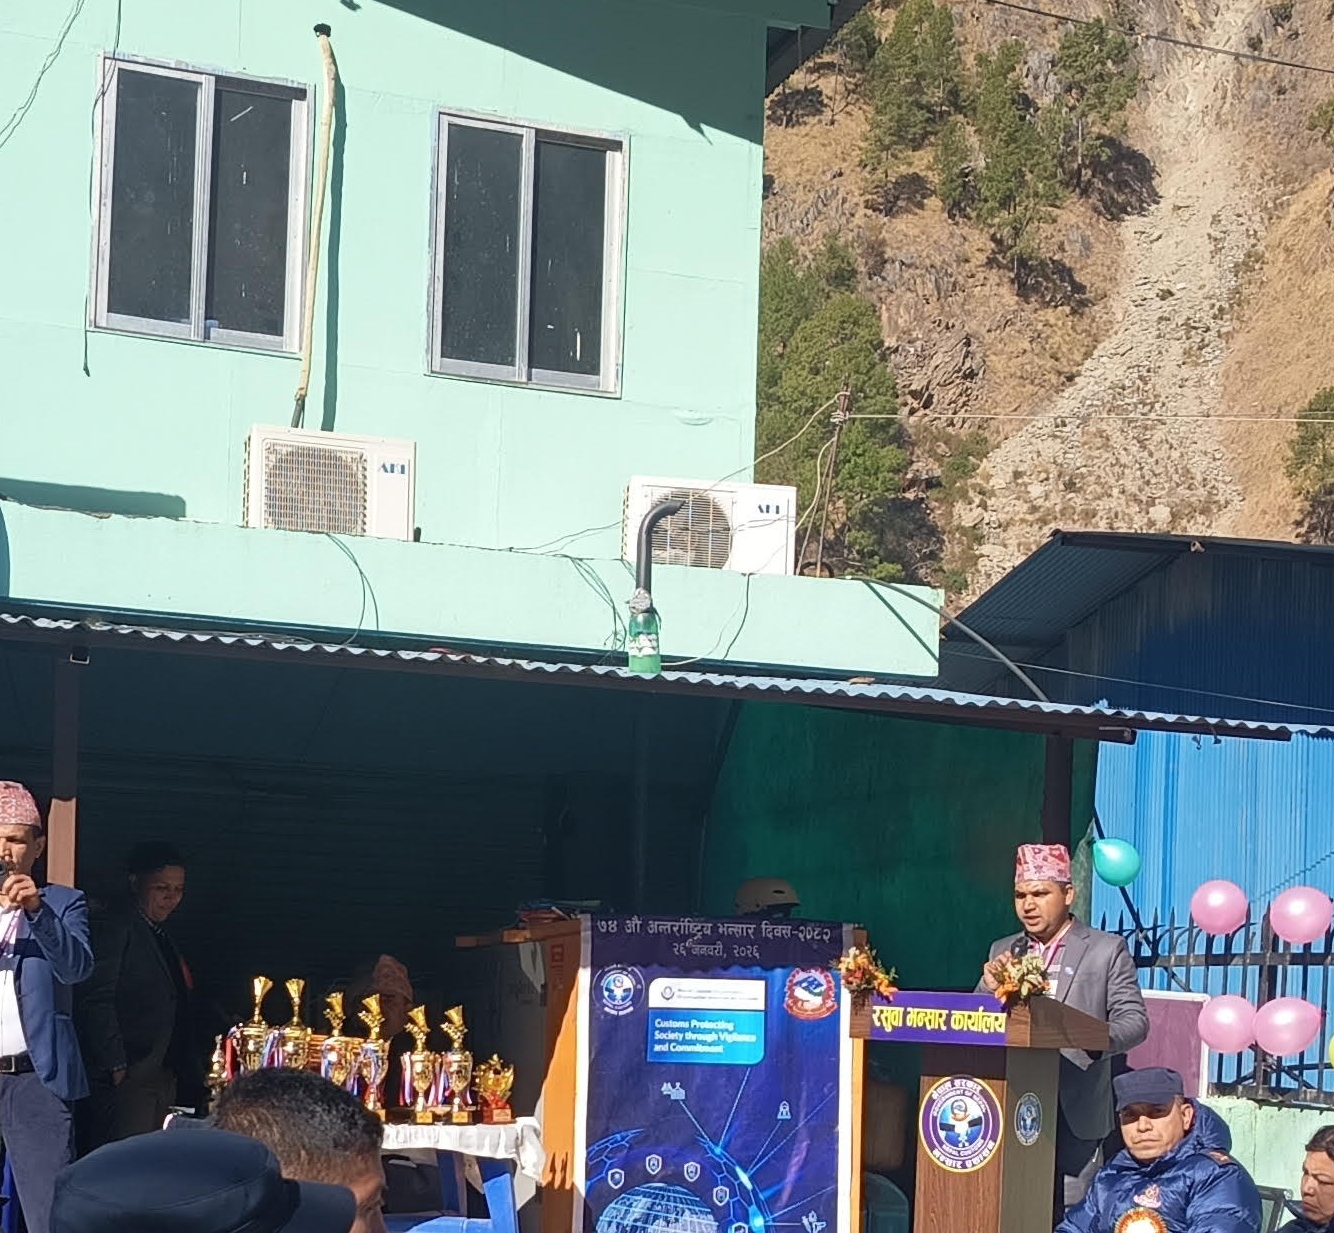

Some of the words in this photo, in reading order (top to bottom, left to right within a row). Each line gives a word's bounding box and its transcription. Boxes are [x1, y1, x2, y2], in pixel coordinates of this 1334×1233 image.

[597, 920, 617, 933] ७४
[717, 921, 755, 939] भन्सार
[673, 943, 687, 957] २६
[733, 944, 759, 958] २०२६
[655, 1019, 689, 1028] Customs
[691, 1019, 734, 1031] Protecting
[872, 1005, 904, 1032] रसुवा
[906, 1007, 948, 1031] भन्सार
[950, 1006, 1007, 1033] कार्यालय
[654, 1030, 683, 1041] Society
[685, 1031, 718, 1043] through
[718, 1032, 757, 1043] Vigilance
[654, 1043, 668, 1052] and
[670, 1043, 724, 1053] Commitment
